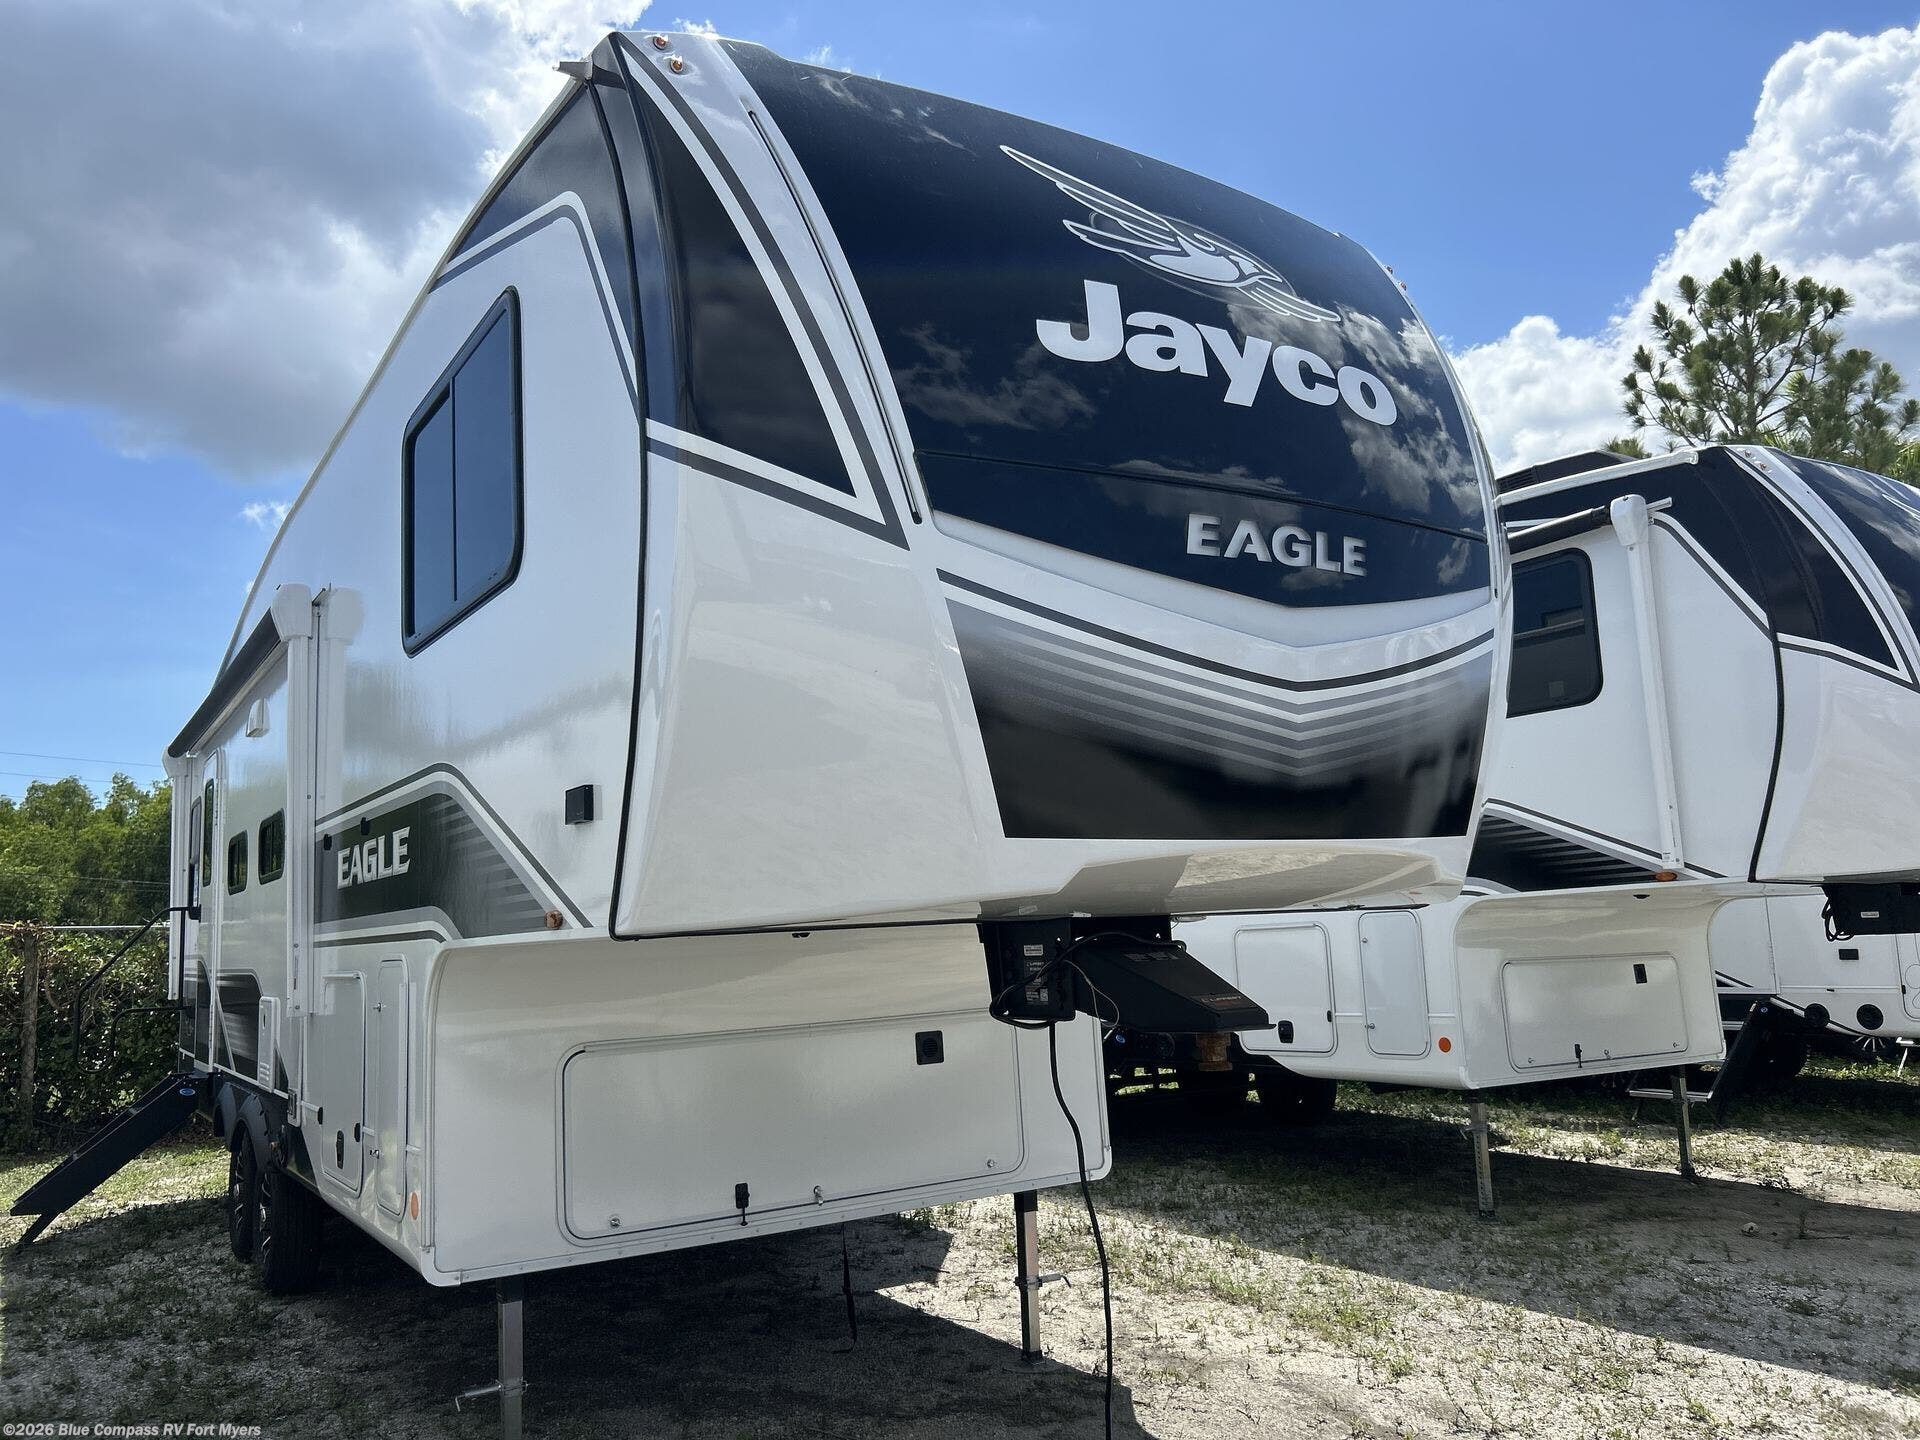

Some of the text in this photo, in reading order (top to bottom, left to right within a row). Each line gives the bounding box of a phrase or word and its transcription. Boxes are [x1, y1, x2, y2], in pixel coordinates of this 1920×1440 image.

[1036, 279, 1398, 426] Jayco
[1187, 513, 1367, 577] EAGLE
[337, 826, 411, 889] EAGLE
